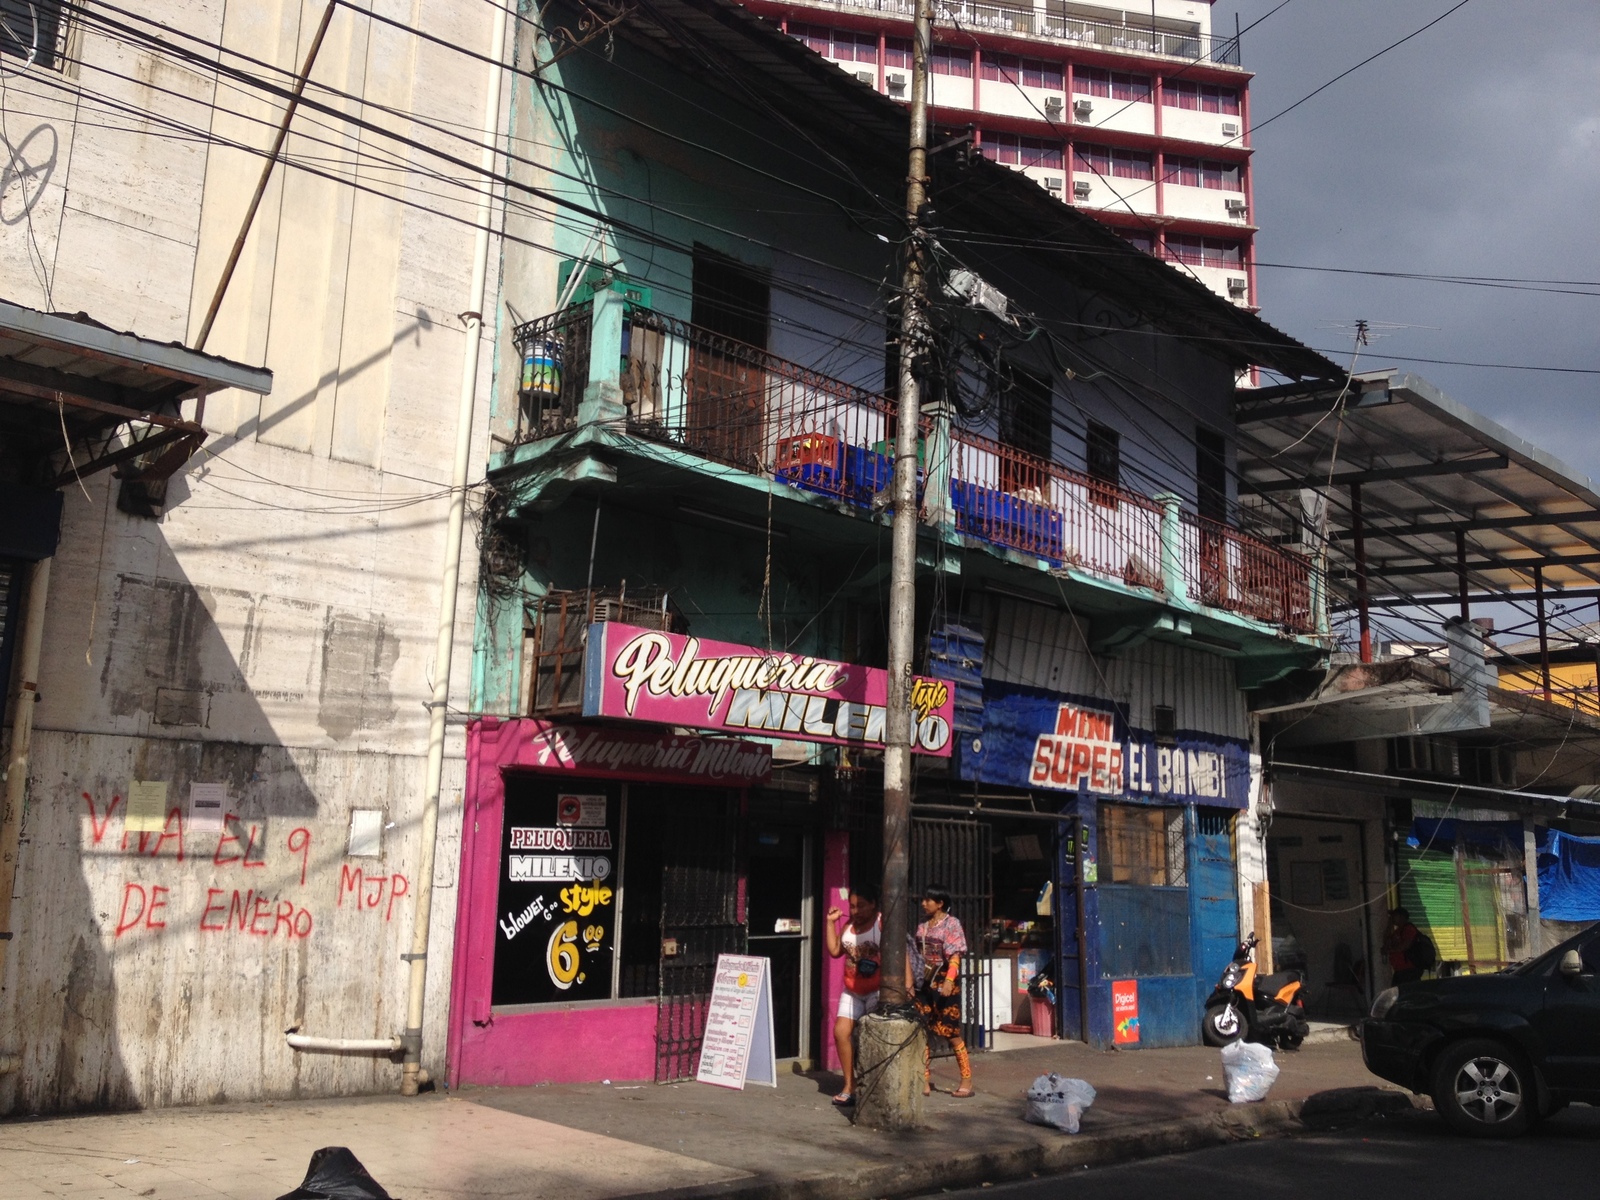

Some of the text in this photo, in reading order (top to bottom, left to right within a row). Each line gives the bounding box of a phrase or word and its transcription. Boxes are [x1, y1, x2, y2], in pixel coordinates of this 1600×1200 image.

[1055, 706, 1113, 742] MINI
[686, 740, 772, 779] Milenio
[1031, 737, 1123, 791] SUPER
[1129, 743, 1152, 792] EL
[213, 812, 265, 867] EL
[287, 827, 311, 885] 9
[511, 828, 612, 850] PELUQUERIA
[509, 855, 611, 881] MILENIO
[115, 882, 313, 938] DE ENERO
[337, 864, 408, 922] MJP
[560, 878, 612, 916] style
[500, 895, 545, 940] blower
[1115, 992, 1135, 1006] Digicel
